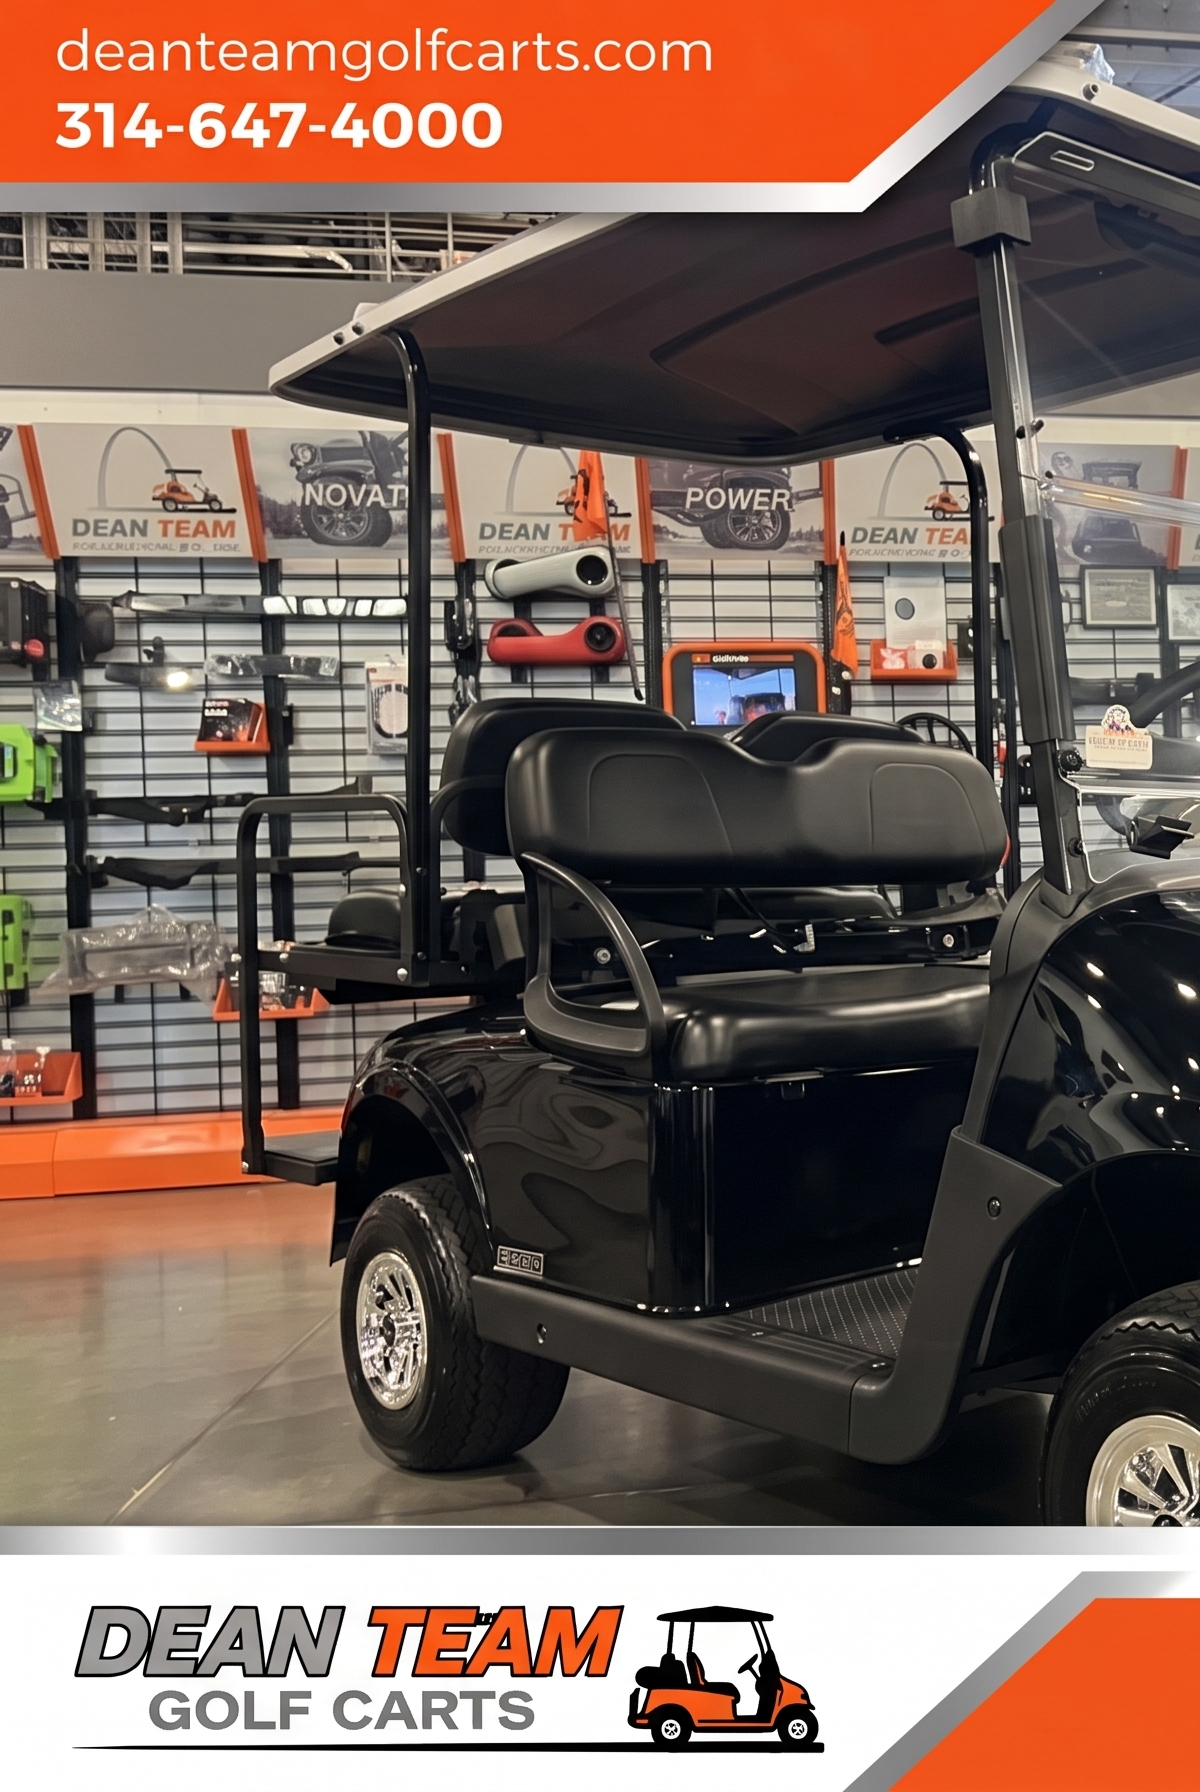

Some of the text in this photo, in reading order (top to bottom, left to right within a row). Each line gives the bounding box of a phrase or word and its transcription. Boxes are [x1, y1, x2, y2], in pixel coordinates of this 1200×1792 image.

[685, 487, 791, 511] POWER
[72, 518, 236, 538] DEAN TEAM
[479, 522, 631, 542] DEAN TM
[851, 527, 970, 545] DEAN TEA
